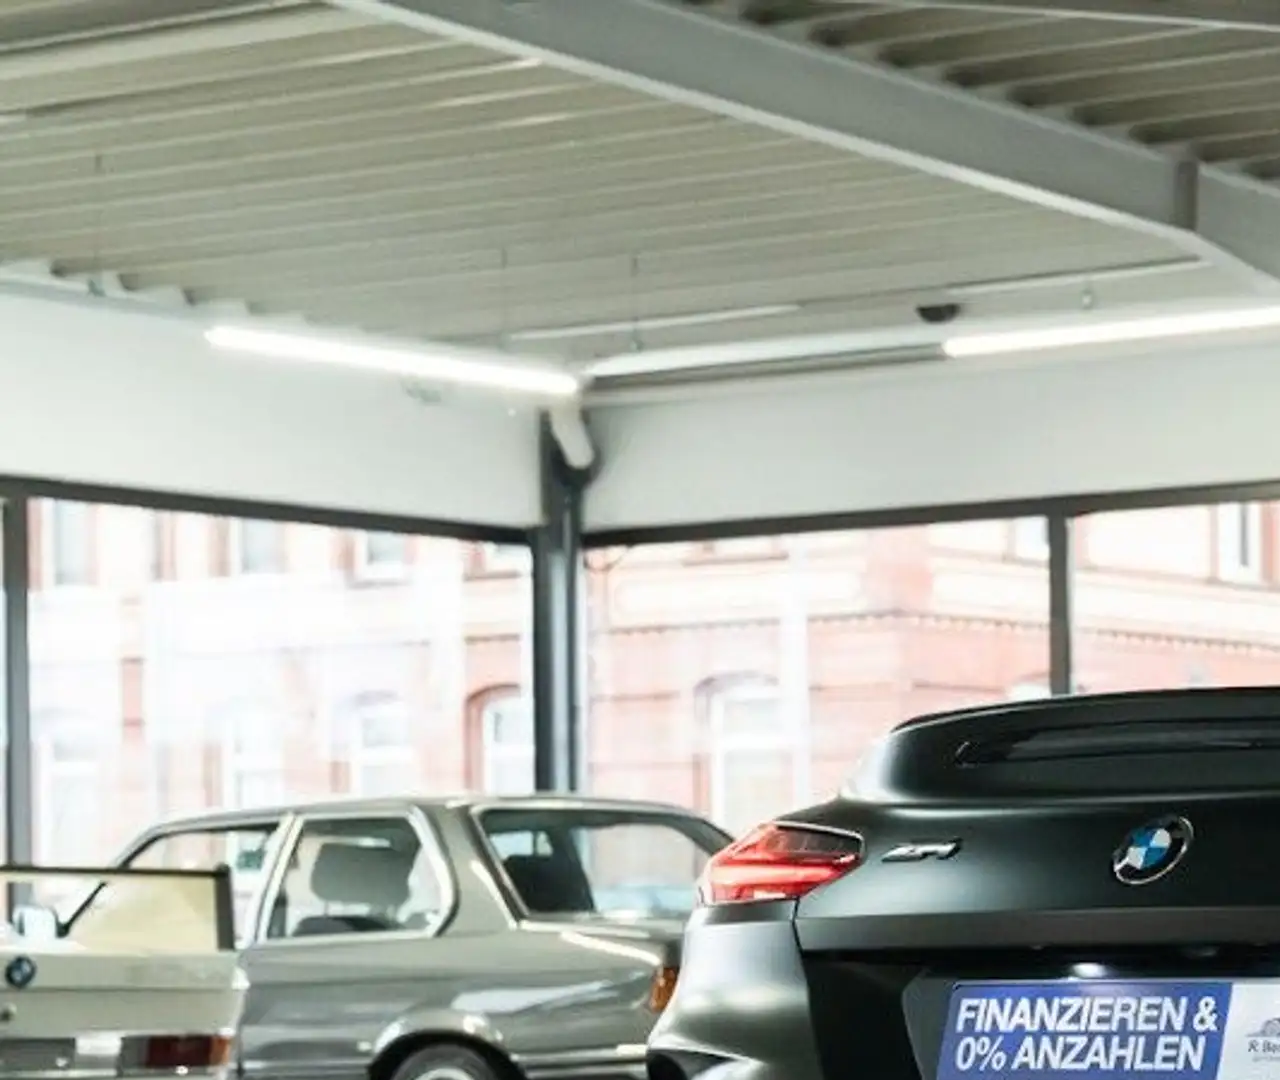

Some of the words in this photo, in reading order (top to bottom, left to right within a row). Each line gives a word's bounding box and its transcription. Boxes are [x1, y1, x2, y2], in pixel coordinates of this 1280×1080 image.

[956, 997, 1185, 1033] FINANZIEREN
[1193, 996, 1219, 1032] &
[956, 1036, 1006, 1071] 0%
[1011, 1035, 1204, 1071] ANZAHLEN
